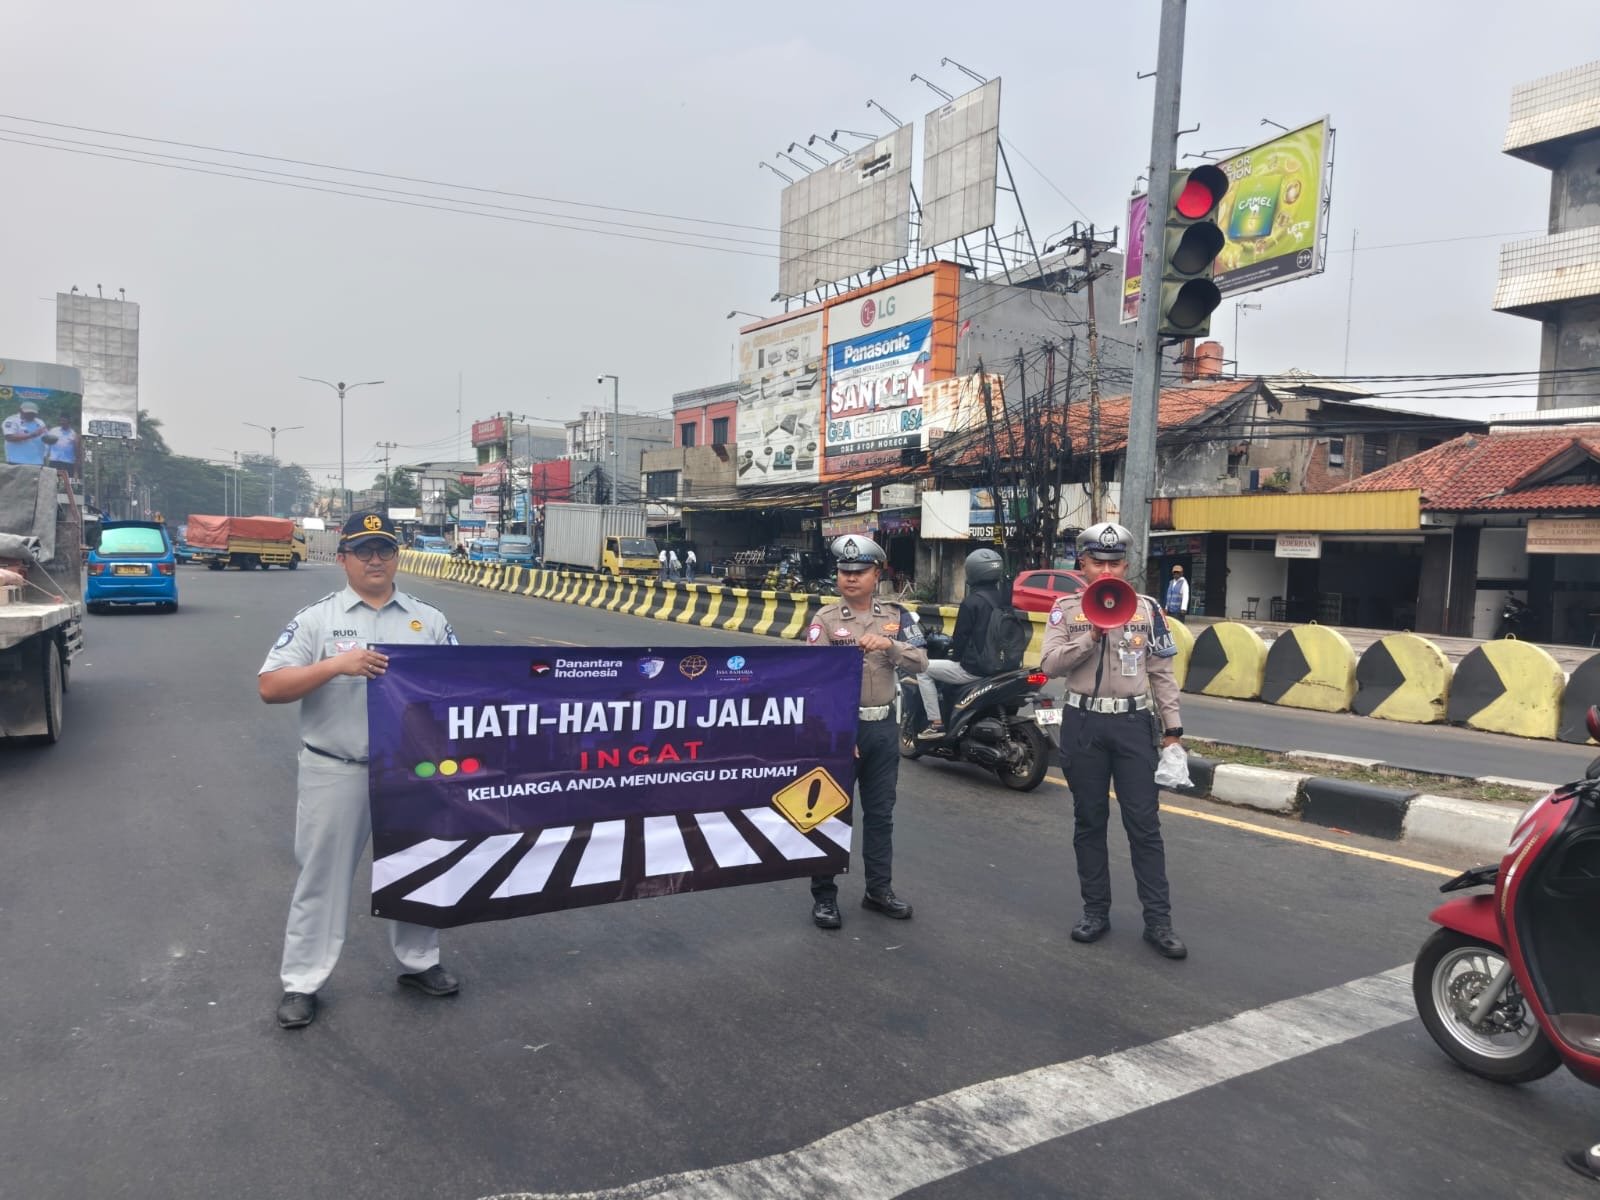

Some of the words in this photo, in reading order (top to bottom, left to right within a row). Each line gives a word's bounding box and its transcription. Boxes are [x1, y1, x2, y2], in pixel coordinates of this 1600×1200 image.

[1238, 196, 1272, 210] CAMEL
[877, 296, 896, 320] LG
[844, 331, 911, 365] Panasonic
[831, 368, 925, 414] SANKEN
[827, 420, 852, 443] GEA
[854, 411, 899, 439] GETRA
[857, 443, 874, 451] STOP
[878, 437, 908, 448] HORECA
[969, 526, 985, 538] FOTO
[333, 629, 357, 637] RUDI
[554, 668, 618, 678] Indonesia
[555, 658, 623, 669] Danantara
[448, 701, 642, 740] HATI-HATI
[653, 700, 687, 730] DI
[697, 697, 805, 728] JALAN
[580, 741, 704, 771] INGAT
[467, 780, 563, 801] KELUARGA
[566, 776, 616, 793] ANDA
[620, 770, 715, 788] MENUNGGU
[719, 768, 738, 781] DI
[741, 765, 798, 780] RUMAH
